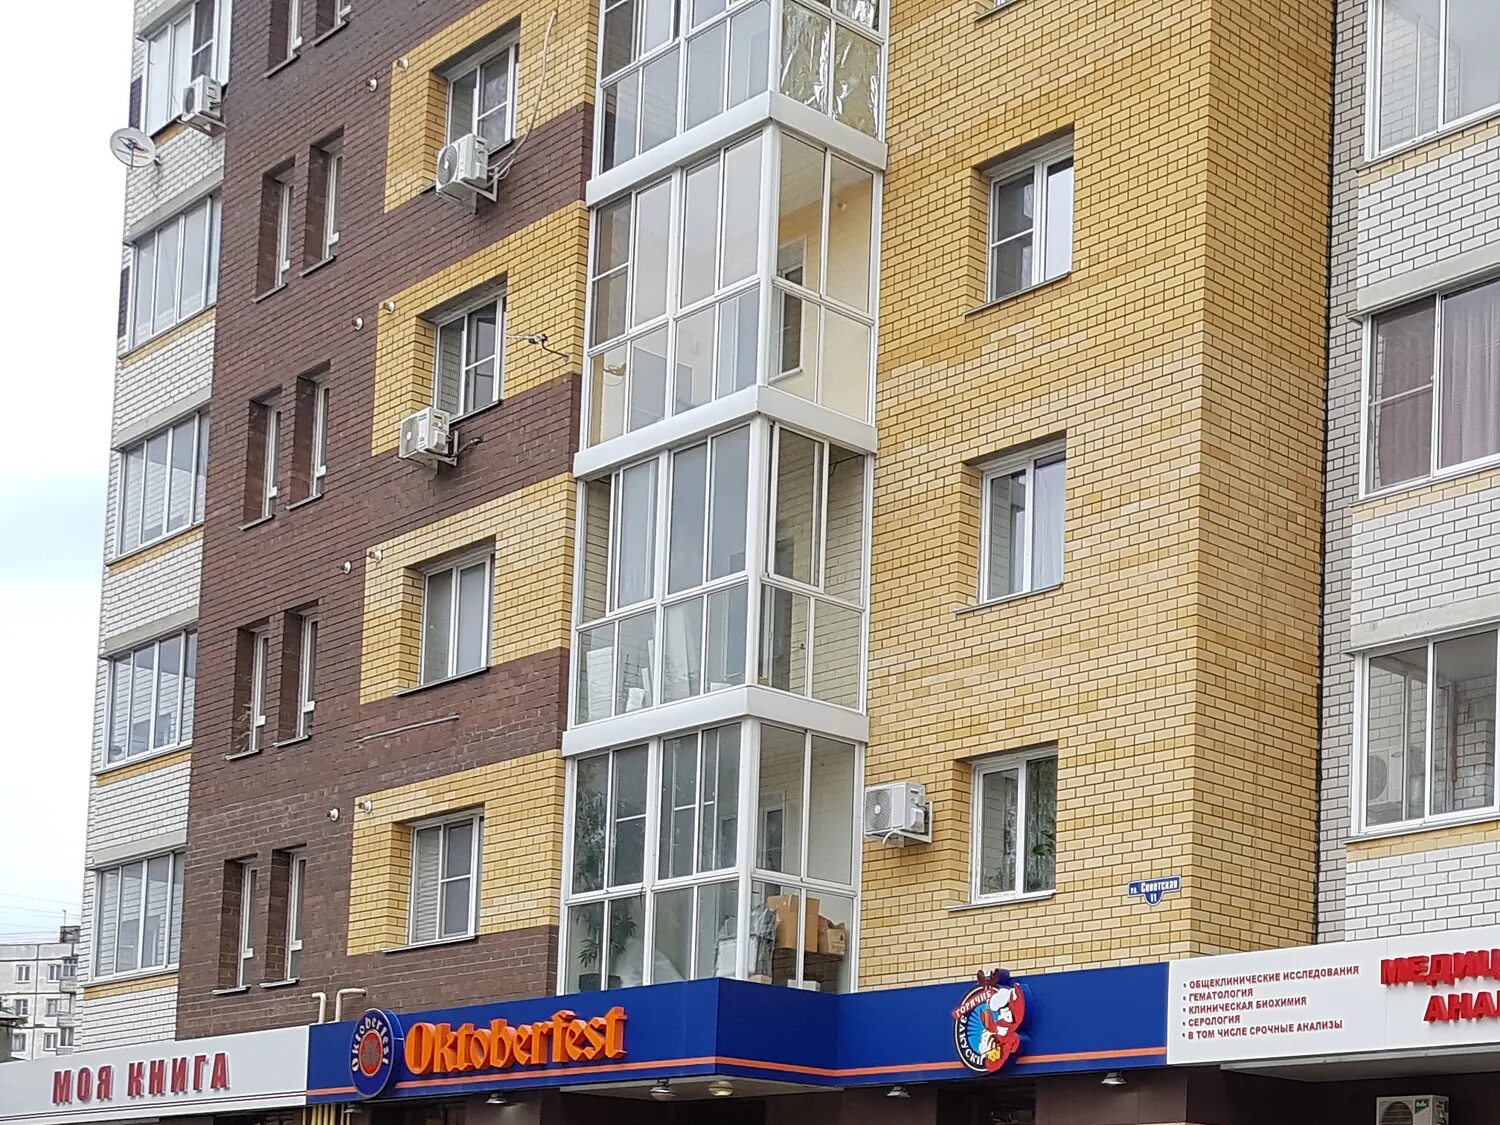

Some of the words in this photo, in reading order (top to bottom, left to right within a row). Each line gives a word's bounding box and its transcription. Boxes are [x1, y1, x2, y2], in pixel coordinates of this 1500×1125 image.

[1141, 880, 1178, 893] Советская
[1150, 893, 1157, 902] 11
[1189, 973, 1281, 990] ОБЩЕКЛИНИЧЕСКИЕ
[1283, 965, 1360, 981] ИССЛЕДОВАНИЯ
[955, 990, 992, 1016] ГОРЯЧИЕ
[1189, 988, 1254, 1002] ГЕМАТОЛОГИЯ
[1188, 1001, 1253, 1015] КЛИНИЧЕСКАЯ
[1256, 996, 1307, 1009] БИОХИМИЯ
[1188, 1015, 1241, 1027] СЕРОЛОГИЯ
[1188, 1031, 1194, 1040] В
[1195, 1029, 1215, 1040] ТОМ
[1217, 1027, 1247, 1038] ЧИСЛЕ
[1249, 1022, 1294, 1036] СРОЧНЫЕ
[1296, 1020, 1343, 1032] АНАЛИЗЫ
[404, 1006, 628, 1075] Oktoberfest
[52, 1065, 113, 1105] МОЯ
[127, 1052, 231, 1098] КНИГА
